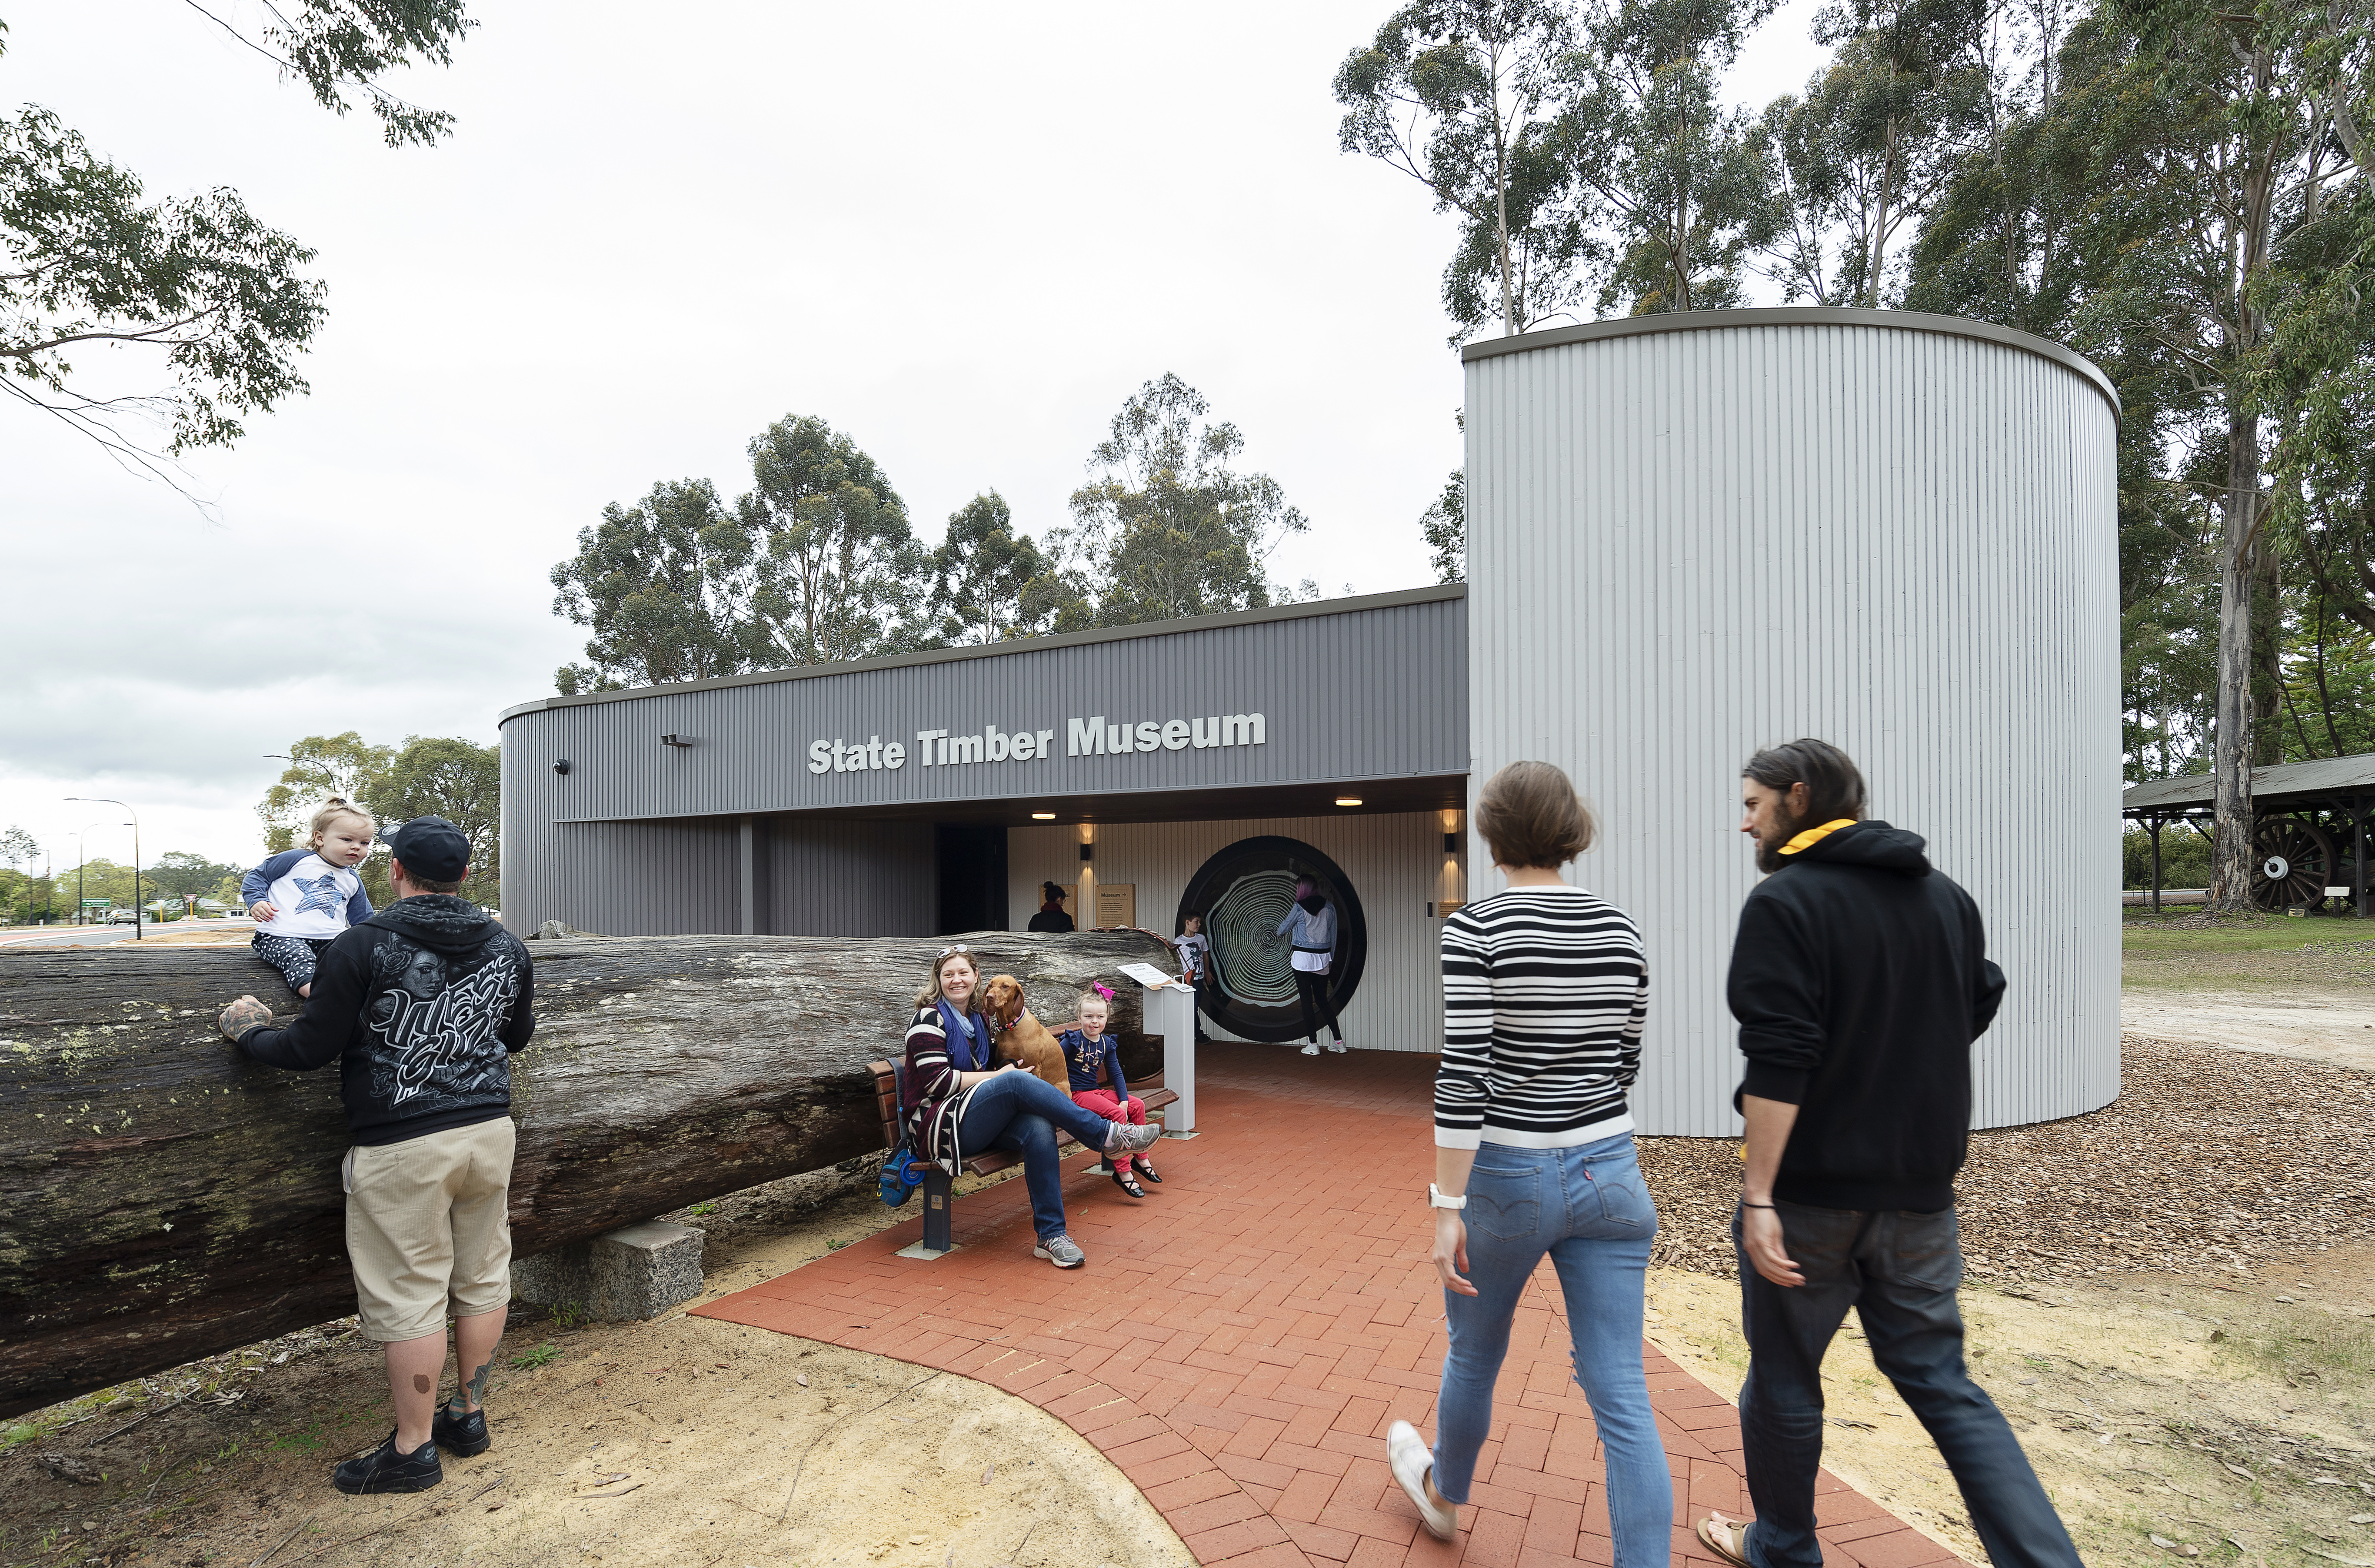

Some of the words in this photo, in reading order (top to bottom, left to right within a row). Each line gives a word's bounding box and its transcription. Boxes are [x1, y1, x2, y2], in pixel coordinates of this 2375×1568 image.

[808, 735, 906, 774] State
[917, 725, 1054, 766] Timber
[1068, 713, 1266, 756] Museum
[470, 1416, 480, 1425] NIKE
